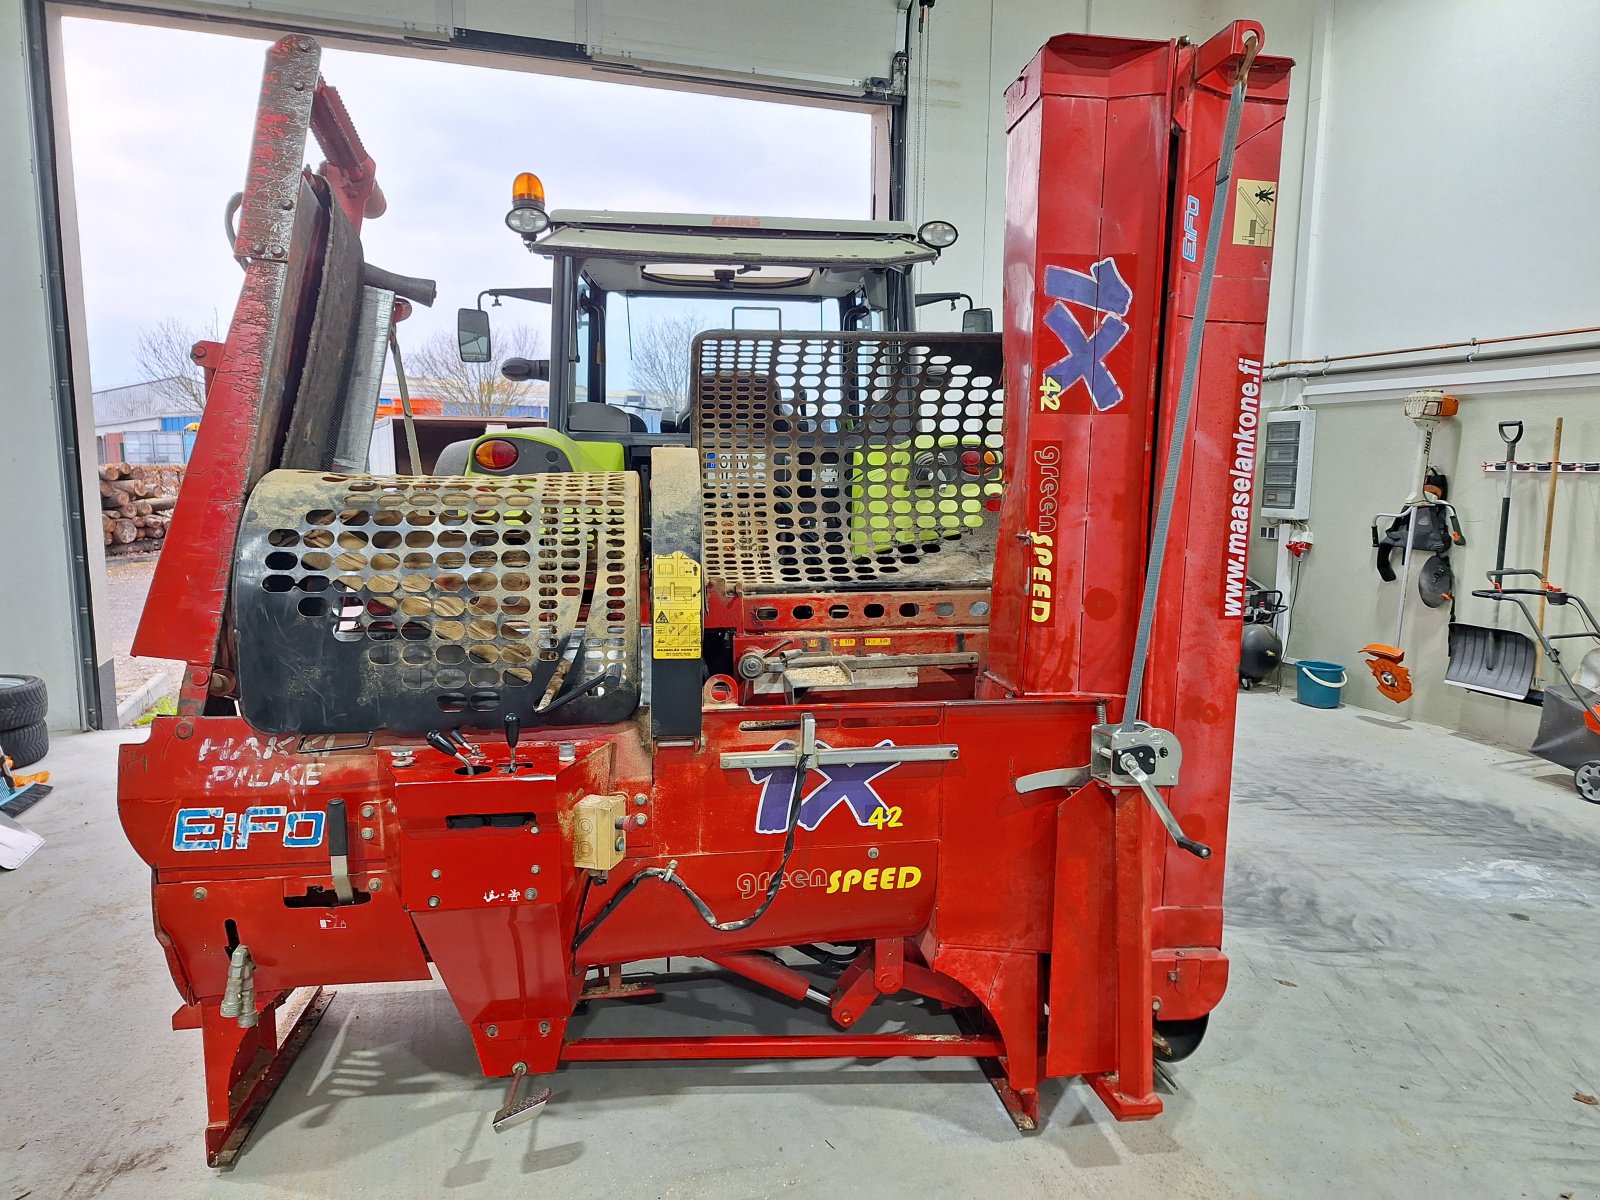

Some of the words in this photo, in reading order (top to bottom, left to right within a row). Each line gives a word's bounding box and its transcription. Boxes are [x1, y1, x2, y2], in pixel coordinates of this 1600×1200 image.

[1039, 376, 1063, 412] 42
[1423, 430, 1432, 455] STIHL
[1224, 357, 1262, 618] www.maaselankone.fi
[198, 735, 336, 762] HAKKI
[205, 763, 326, 789] PILKE
[868, 806, 904, 830] 42
